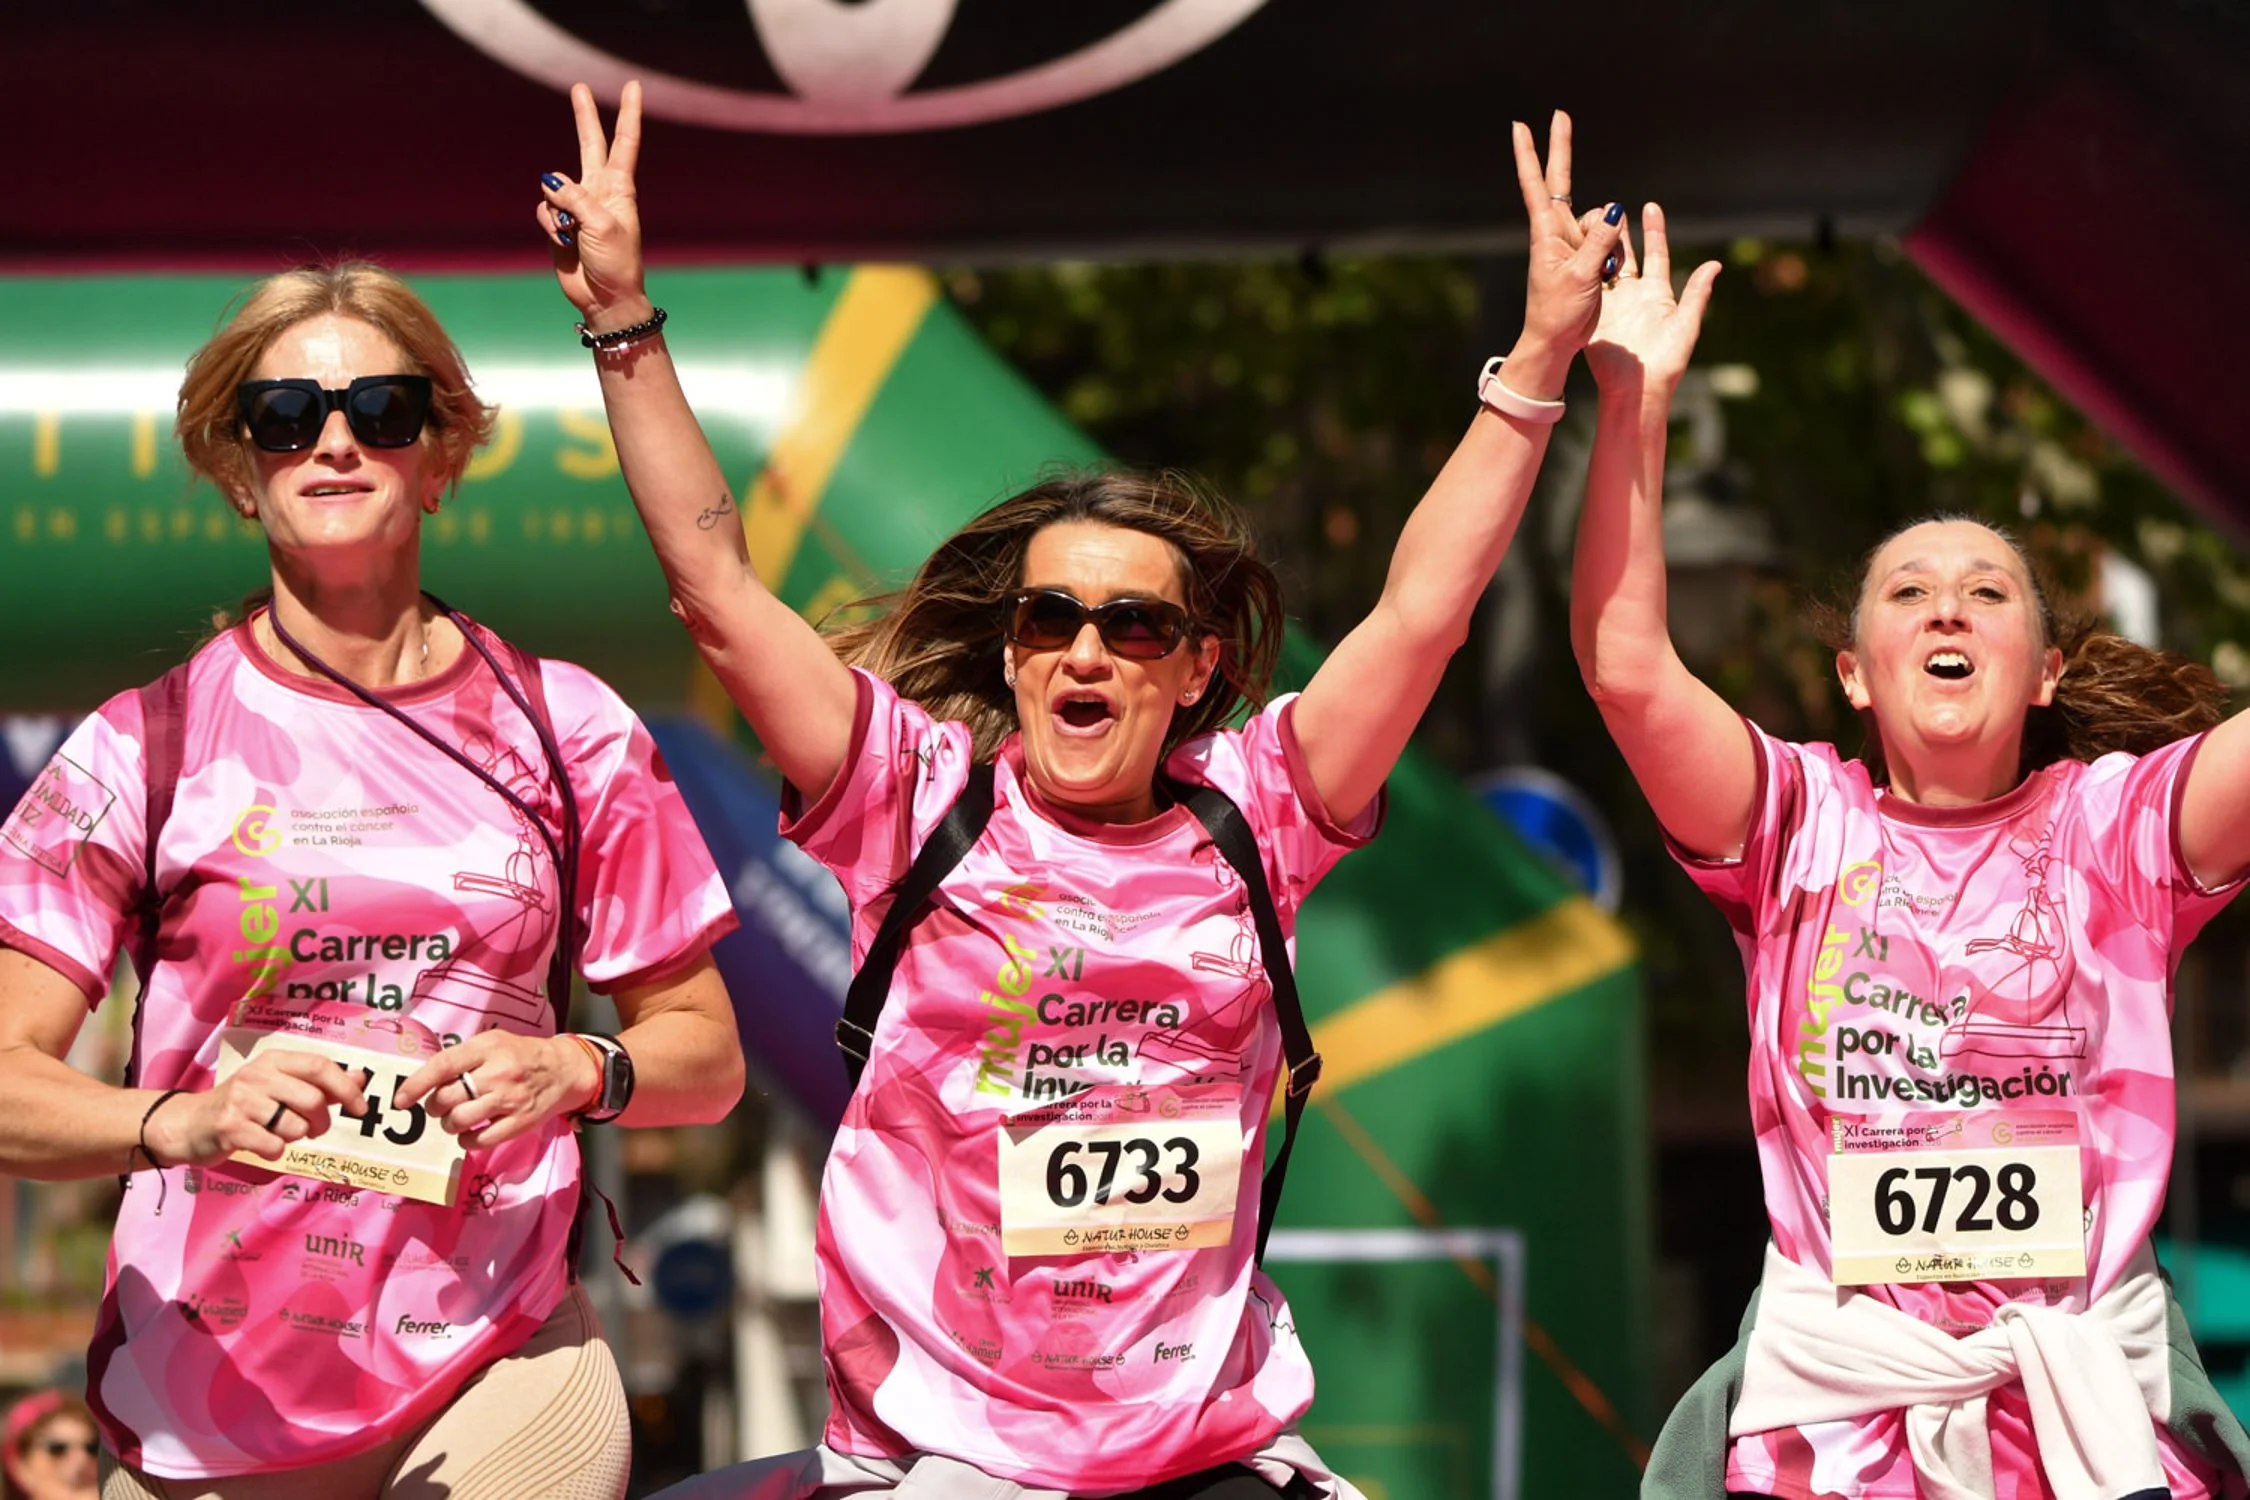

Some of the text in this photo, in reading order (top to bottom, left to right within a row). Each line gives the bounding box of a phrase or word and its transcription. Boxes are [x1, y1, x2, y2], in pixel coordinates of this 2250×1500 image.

[290, 803, 419, 820] asociación española
[291, 820, 394, 833] contra el cáncer
[293, 835, 362, 848] en La Rioja
[288, 877, 330, 914] XI
[1056, 904, 1096, 921] contra
[1055, 917, 1070, 927] en
[1072, 919, 1086, 931] La
[289, 928, 454, 963] Carrera
[1852, 926, 1888, 962] XI
[1042, 944, 1085, 982] XI
[287, 973, 405, 1012] por la
[1843, 971, 1968, 1027] Carrera
[311, 1013, 332, 1024] por
[334, 1014, 346, 1026] la
[976, 932, 1039, 1096] mujer
[1036, 993, 1181, 1031] Carrera
[1026, 1034, 1129, 1070] por la
[1835, 1025, 1938, 1071] por la
[336, 1062, 427, 1146] 45
[1836, 1064, 2078, 1109] Investigación
[1079, 1101, 1100, 1112] por
[1100, 1099, 1112, 1110] la
[1844, 1124, 1926, 1140] XI Carrera por
[1844, 1137, 1919, 1150] investigación
[340, 1160, 390, 1181] HOUSE
[1046, 1136, 1200, 1209] 6733
[304, 1186, 360, 1208] La Rioja
[1874, 1162, 2040, 1236] 6728
[1128, 1227, 1172, 1241] HOUSE
